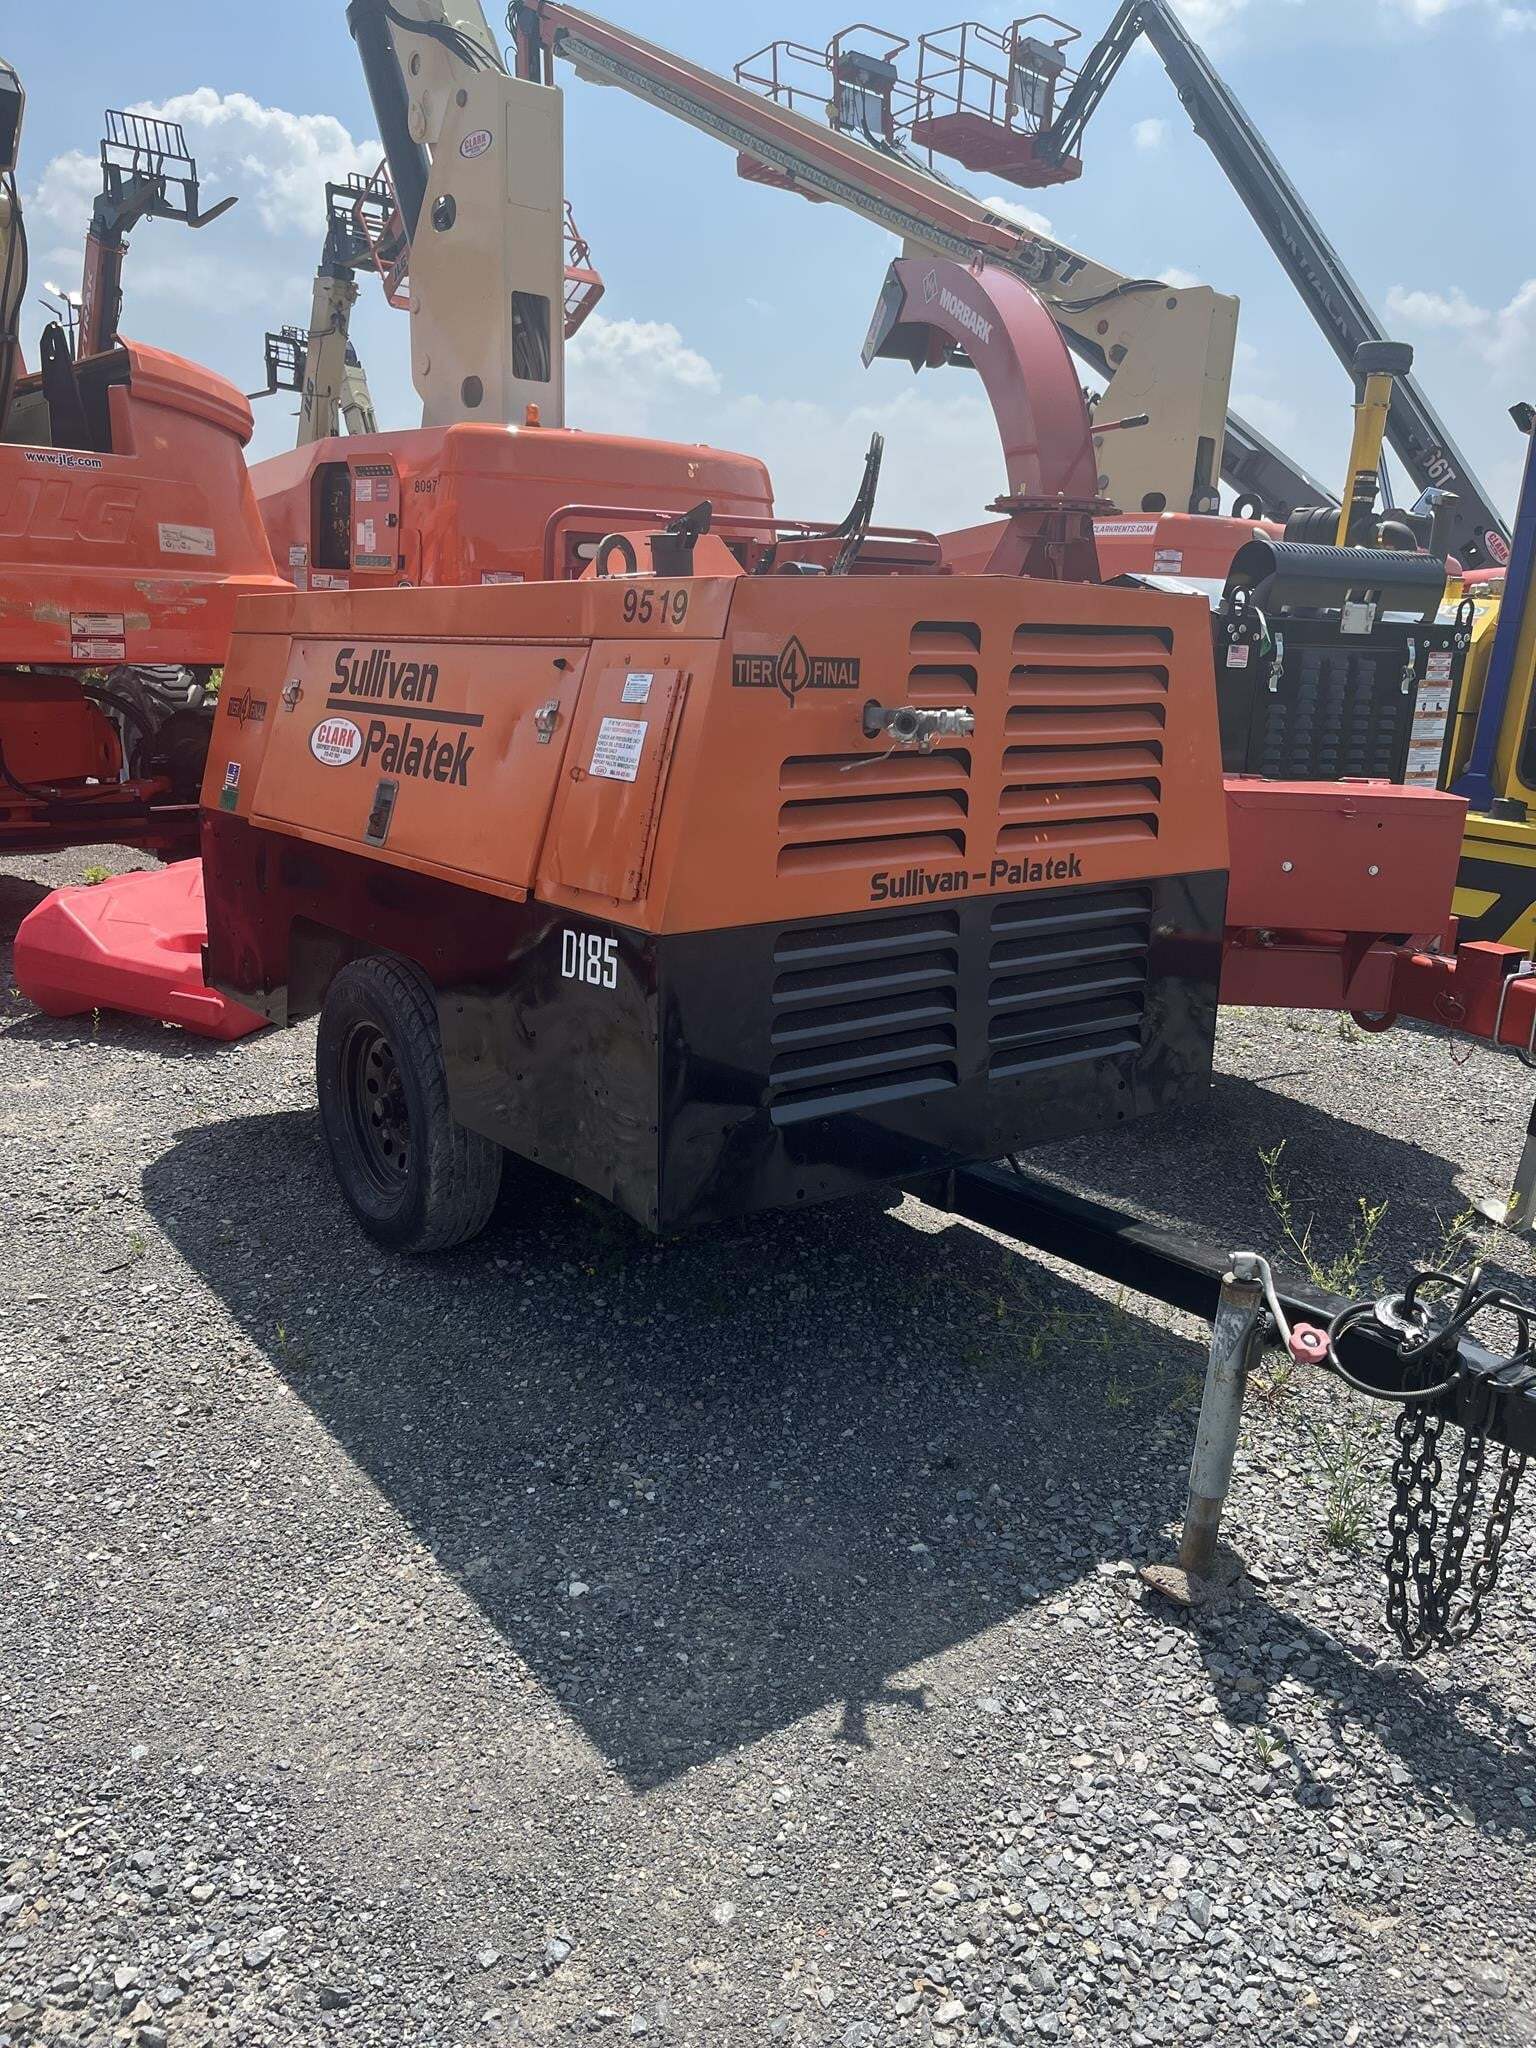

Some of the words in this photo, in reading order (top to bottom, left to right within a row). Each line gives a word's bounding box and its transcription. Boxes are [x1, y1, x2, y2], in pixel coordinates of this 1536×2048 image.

[940, 287, 993, 345] MORBARK
[25, 452, 102, 469] www.jlg.com
[414, 479, 438, 493] 8097
[623, 588, 689, 625] 9519
[329, 648, 439, 702] Sullivan
[735, 660, 773, 683] TIER
[782, 648, 799, 692] 4
[814, 661, 858, 685] FINAL
[317, 724, 357, 748] CLARK
[360, 719, 475, 786] Palatek
[562, 929, 618, 989] D185
